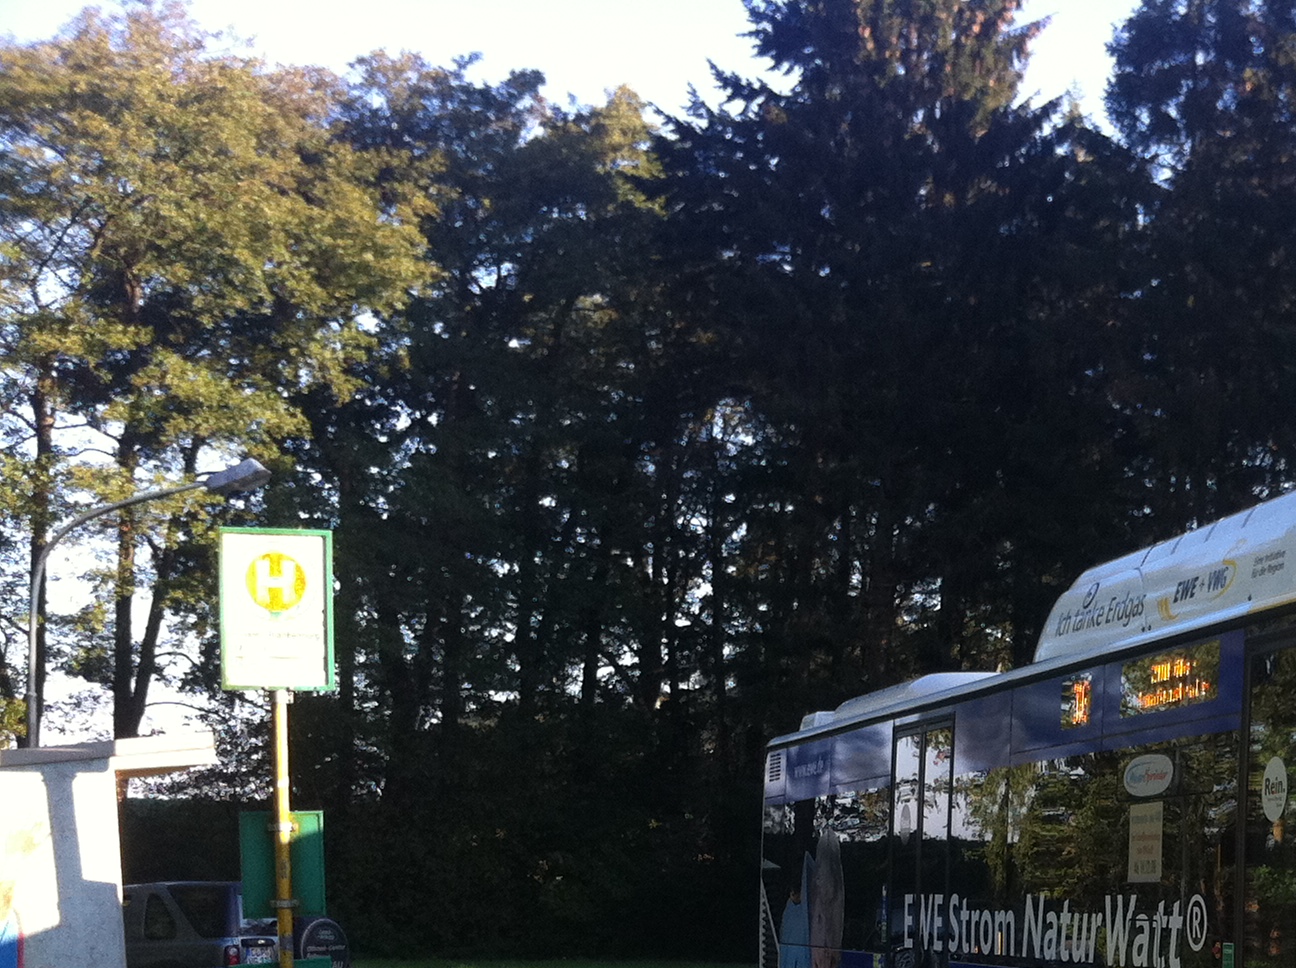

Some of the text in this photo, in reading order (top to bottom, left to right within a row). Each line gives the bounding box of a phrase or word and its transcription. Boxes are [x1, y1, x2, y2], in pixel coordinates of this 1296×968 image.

[256, 560, 296, 602] H
[1173, 576, 1200, 603] EWE
[1208, 566, 1229, 593] VWG
[1055, 591, 1147, 638] Ich tanke Erdgas
[1265, 776, 1285, 796] Rein.
